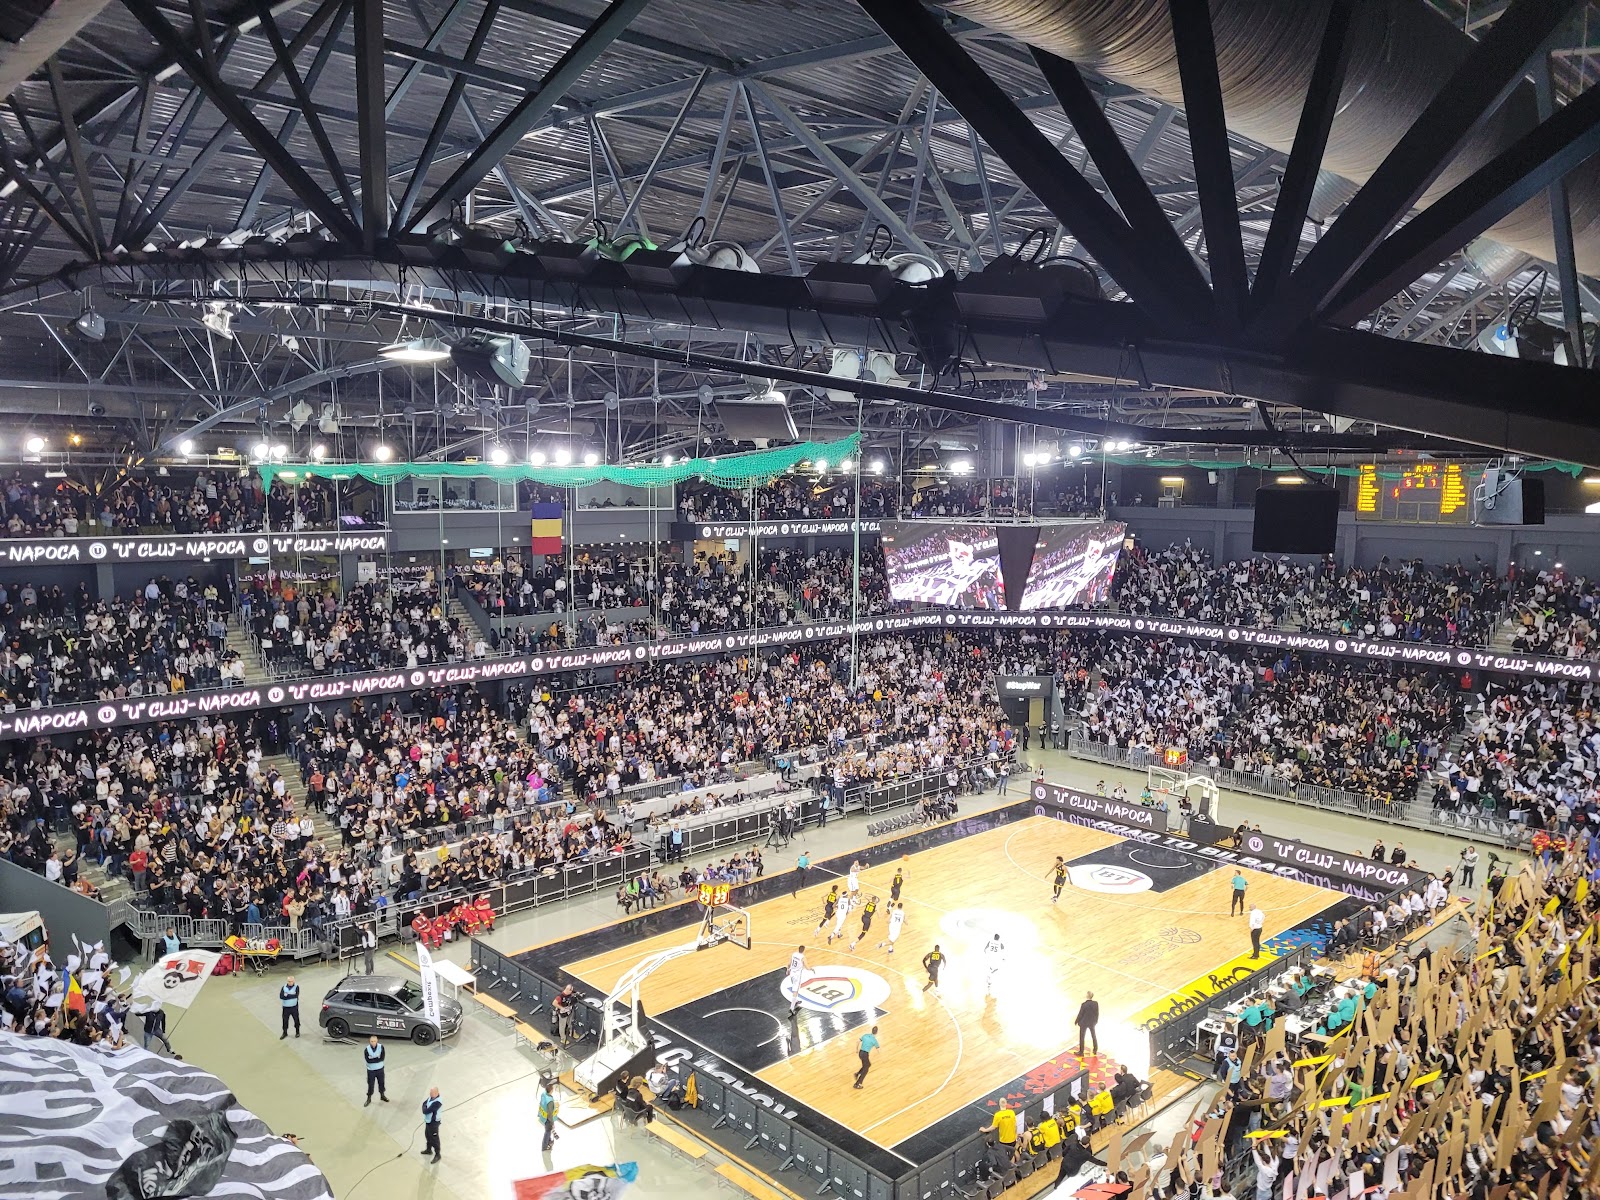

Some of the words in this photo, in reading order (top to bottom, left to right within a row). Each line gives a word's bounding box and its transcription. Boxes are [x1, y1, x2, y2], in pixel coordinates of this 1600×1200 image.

[113, 542, 135, 557] "U"
[273, 538, 291, 552] "U"
[885, 619, 894, 628] "U"
[958, 615, 972, 624] "U"
[1054, 616, 1068, 625] "U"
[816, 627, 825, 636] "U"
[1146, 621, 1159, 631] "U"
[737, 635, 749, 646] "U"
[1241, 631, 1256, 641] "U"
[648, 645, 661, 656] "U"
[1350, 642, 1367, 653] "U"
[546, 656, 561, 669] "U"
[1475, 654, 1494, 666] "U"
[427, 669, 445, 683] "U"
[288, 684, 309, 699] "U"
[122, 703, 146, 719] "U"
[1053, 789, 1069, 803] "U"
[1163, 838, 1198, 850] TO
[1273, 841, 1294, 858] "U"
[714, 892, 727, 904] 23
[806, 984, 845, 1001] BT
